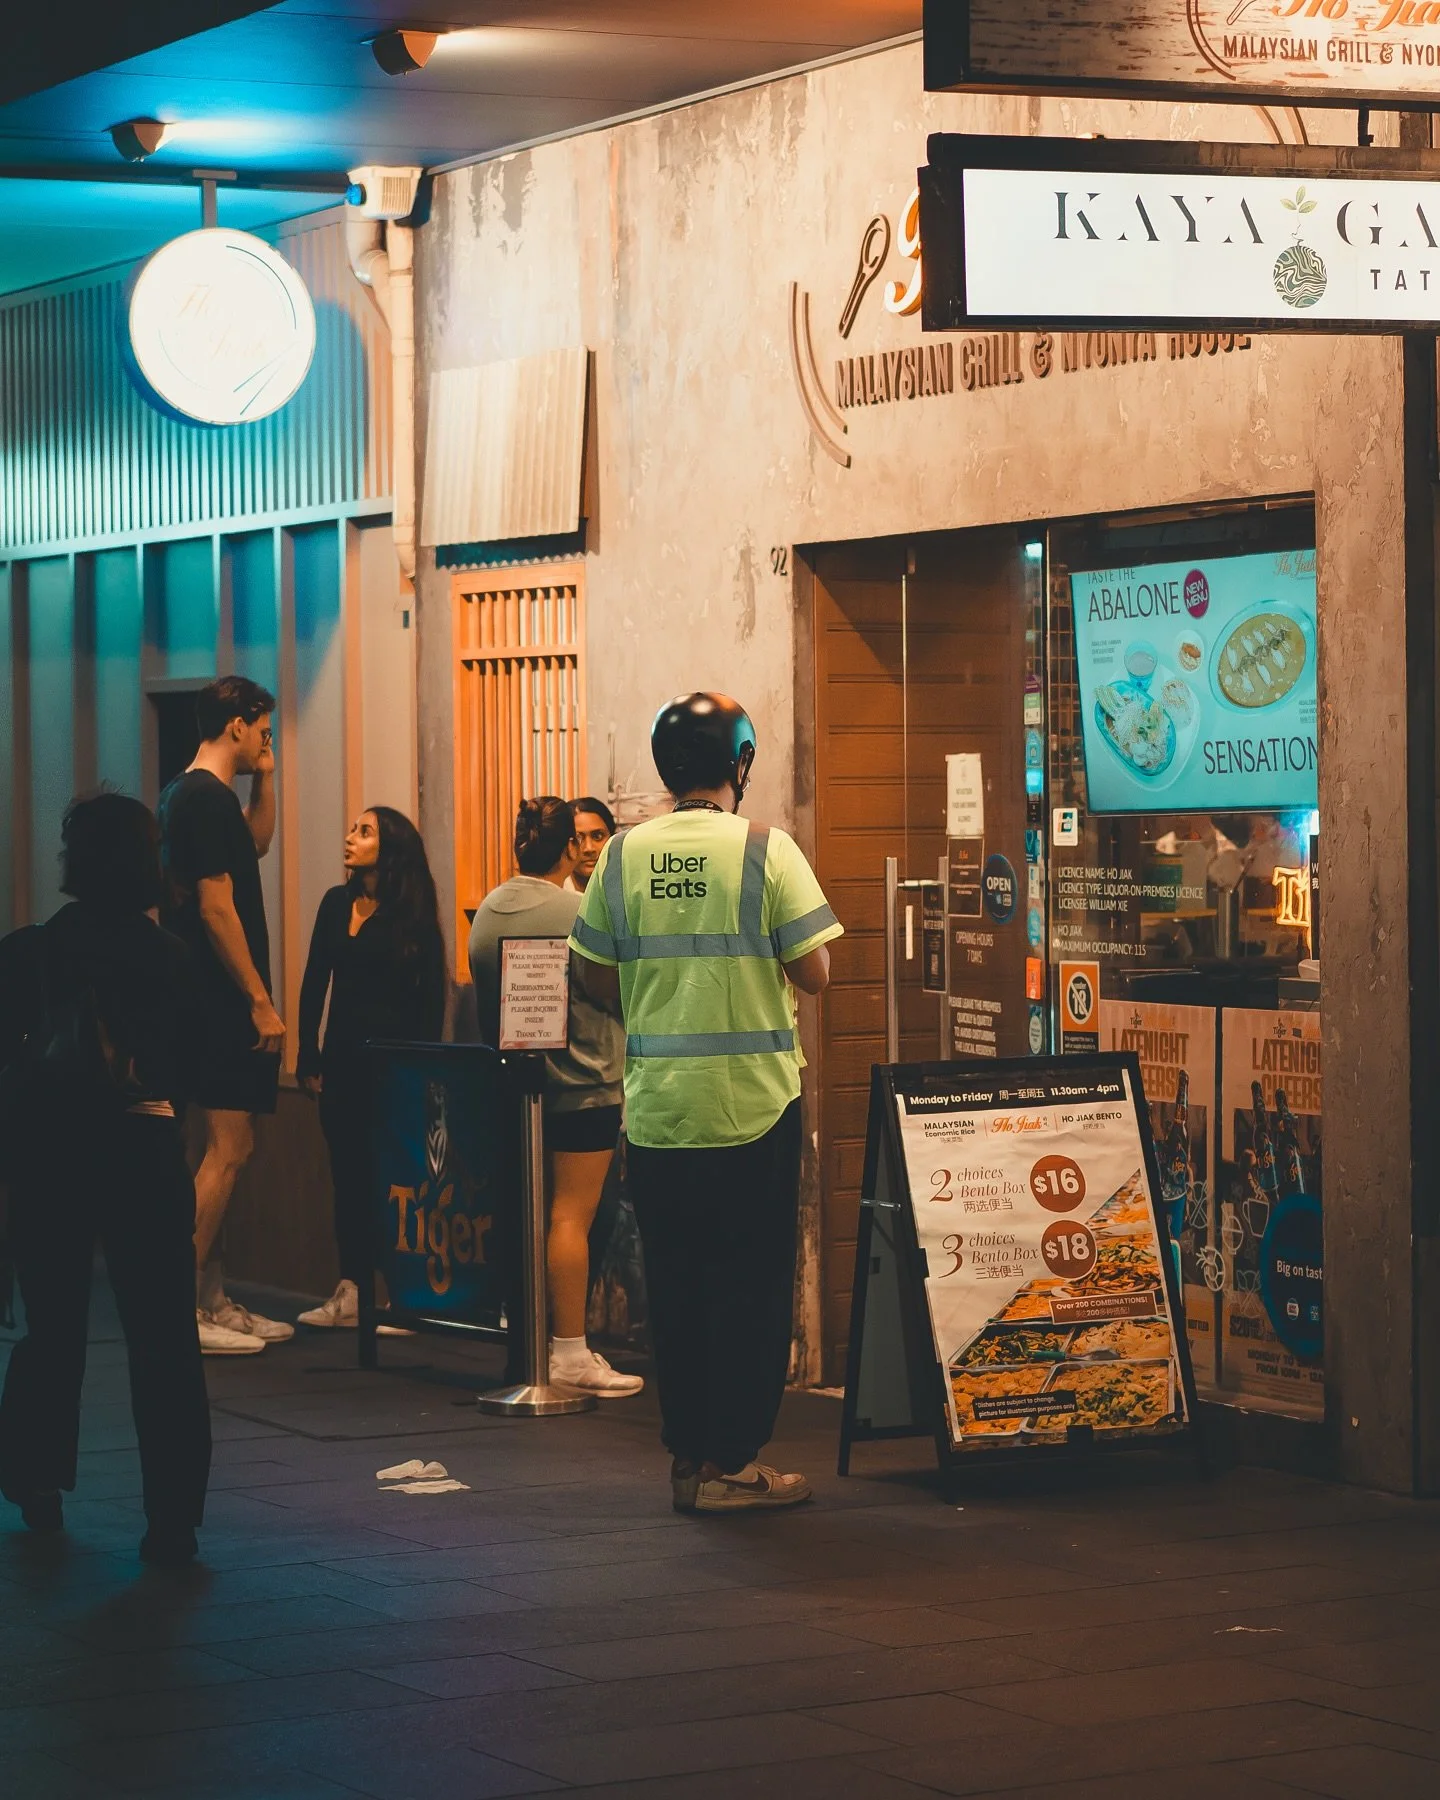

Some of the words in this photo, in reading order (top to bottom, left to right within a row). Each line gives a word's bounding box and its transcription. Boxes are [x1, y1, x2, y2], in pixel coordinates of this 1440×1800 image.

[1223, 35, 1318, 61] MALAYSIAN
[1327, 40, 1372, 63] GRILL
[1380, 43, 1393, 64] &
[1054, 191, 1264, 244] KAYA
[1370, 269, 1431, 290] TAT
[834, 342, 954, 409] MALAYSIAN
[960, 332, 1024, 392] GRILL
[1030, 332, 1055, 379] &
[770, 547, 788, 576] 92
[1087, 570, 1114, 585] TASTE
[1119, 568, 1136, 582] THE
[1186, 579, 1204, 596] NEW
[1088, 581, 1181, 622] ABALONE
[1186, 589, 1208, 609] MENU
[1203, 737, 1318, 775] SENSATION
[650, 853, 707, 874] Uber
[1058, 867, 1084, 878] LICENCE
[1085, 867, 1105, 879] NAME:
[1107, 868, 1117, 879] HO
[1119, 868, 1132, 880] JIAK
[650, 878, 707, 899] Eats
[987, 876, 1011, 892] OPEN
[1058, 882, 1084, 894] LICENCE
[1086, 883, 1103, 895] TYPE:
[1104, 884, 1174, 898] LIQUOR-ON-PREMISES
[1176, 887, 1203, 899] LICENCE
[1058, 898, 1088, 910] LICENSEE:
[1089, 899, 1116, 911] WILLIAM
[1117, 900, 1128, 912] XIE
[956, 931, 977, 945] OPENING
[977, 933, 994, 947] HOURS
[1058, 925, 1068, 936] HO
[1069, 926, 1082, 937] JIAK
[508, 952, 526, 960] WALK
[1059, 940, 1091, 953] MAXIMUM
[1092, 942, 1132, 954] OCCUPANCY:
[1134, 944, 1146, 956] 115
[511, 983, 554, 991] RESERVATIONS
[537, 1030, 552, 1038] YOU
[1111, 1027, 1190, 1065] LATENIGHT
[909, 1095, 949, 1105] Monday
[949, 1094, 961, 1102] to
[962, 1092, 993, 1103] Friday
[999, 1088, 1046, 1101] 周一至周五
[1050, 1087, 1088, 1096] 11.30am
[1096, 1084, 1120, 1095] 4pm
[924, 1120, 974, 1130] MALAYSIAN
[1076, 1114, 1094, 1122] JIAK
[1096, 1112, 1122, 1121] BENTO
[925, 1130, 959, 1138] Economic
[957, 1166, 1004, 1182] choices
[1033, 1168, 1080, 1196] $16
[929, 1168, 953, 1203] 2
[960, 1184, 998, 1199] Bento
[1002, 1181, 1026, 1195] Box
[963, 1197, 1014, 1214] 两选便当
[389, 1183, 492, 1296] Tiger
[969, 1231, 1015, 1248] choices
[1044, 1232, 1090, 1262] $18
[938, 1233, 964, 1279] 3
[971, 1250, 1009, 1264] Bento
[1013, 1247, 1039, 1261] Box
[975, 1264, 1024, 1280] 三选便当
[1276, 1260, 1291, 1277] Big
[1292, 1266, 1304, 1277] on
[1075, 1301, 1089, 1309] 200
[1090, 1296, 1148, 1307] COMBINATIONS!
